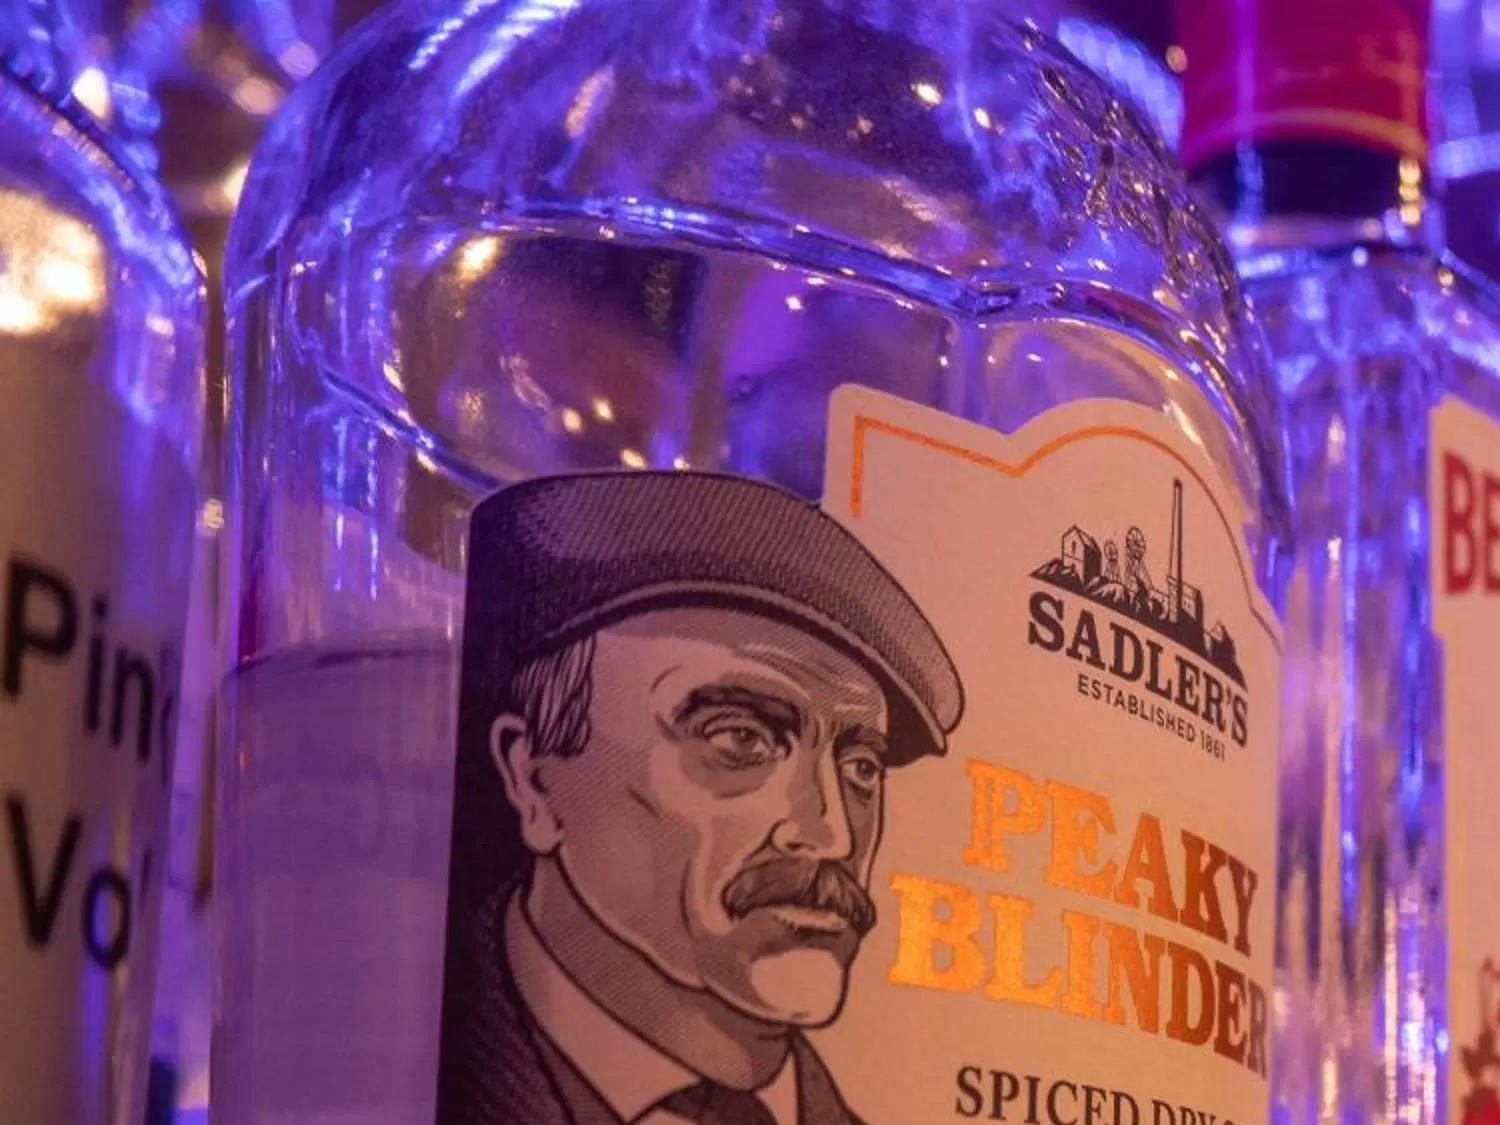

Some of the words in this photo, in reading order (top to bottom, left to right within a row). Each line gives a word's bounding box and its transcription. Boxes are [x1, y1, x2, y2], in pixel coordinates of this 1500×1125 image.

[1028, 591, 1248, 748] SADLER'S
[1077, 673, 1196, 744] ESTABLISHED
[1200, 730, 1226, 763] 1861
[4, 793, 154, 977] Vo
[962, 758, 1258, 957] PEAKY
[887, 871, 1267, 1081] BLINDER
